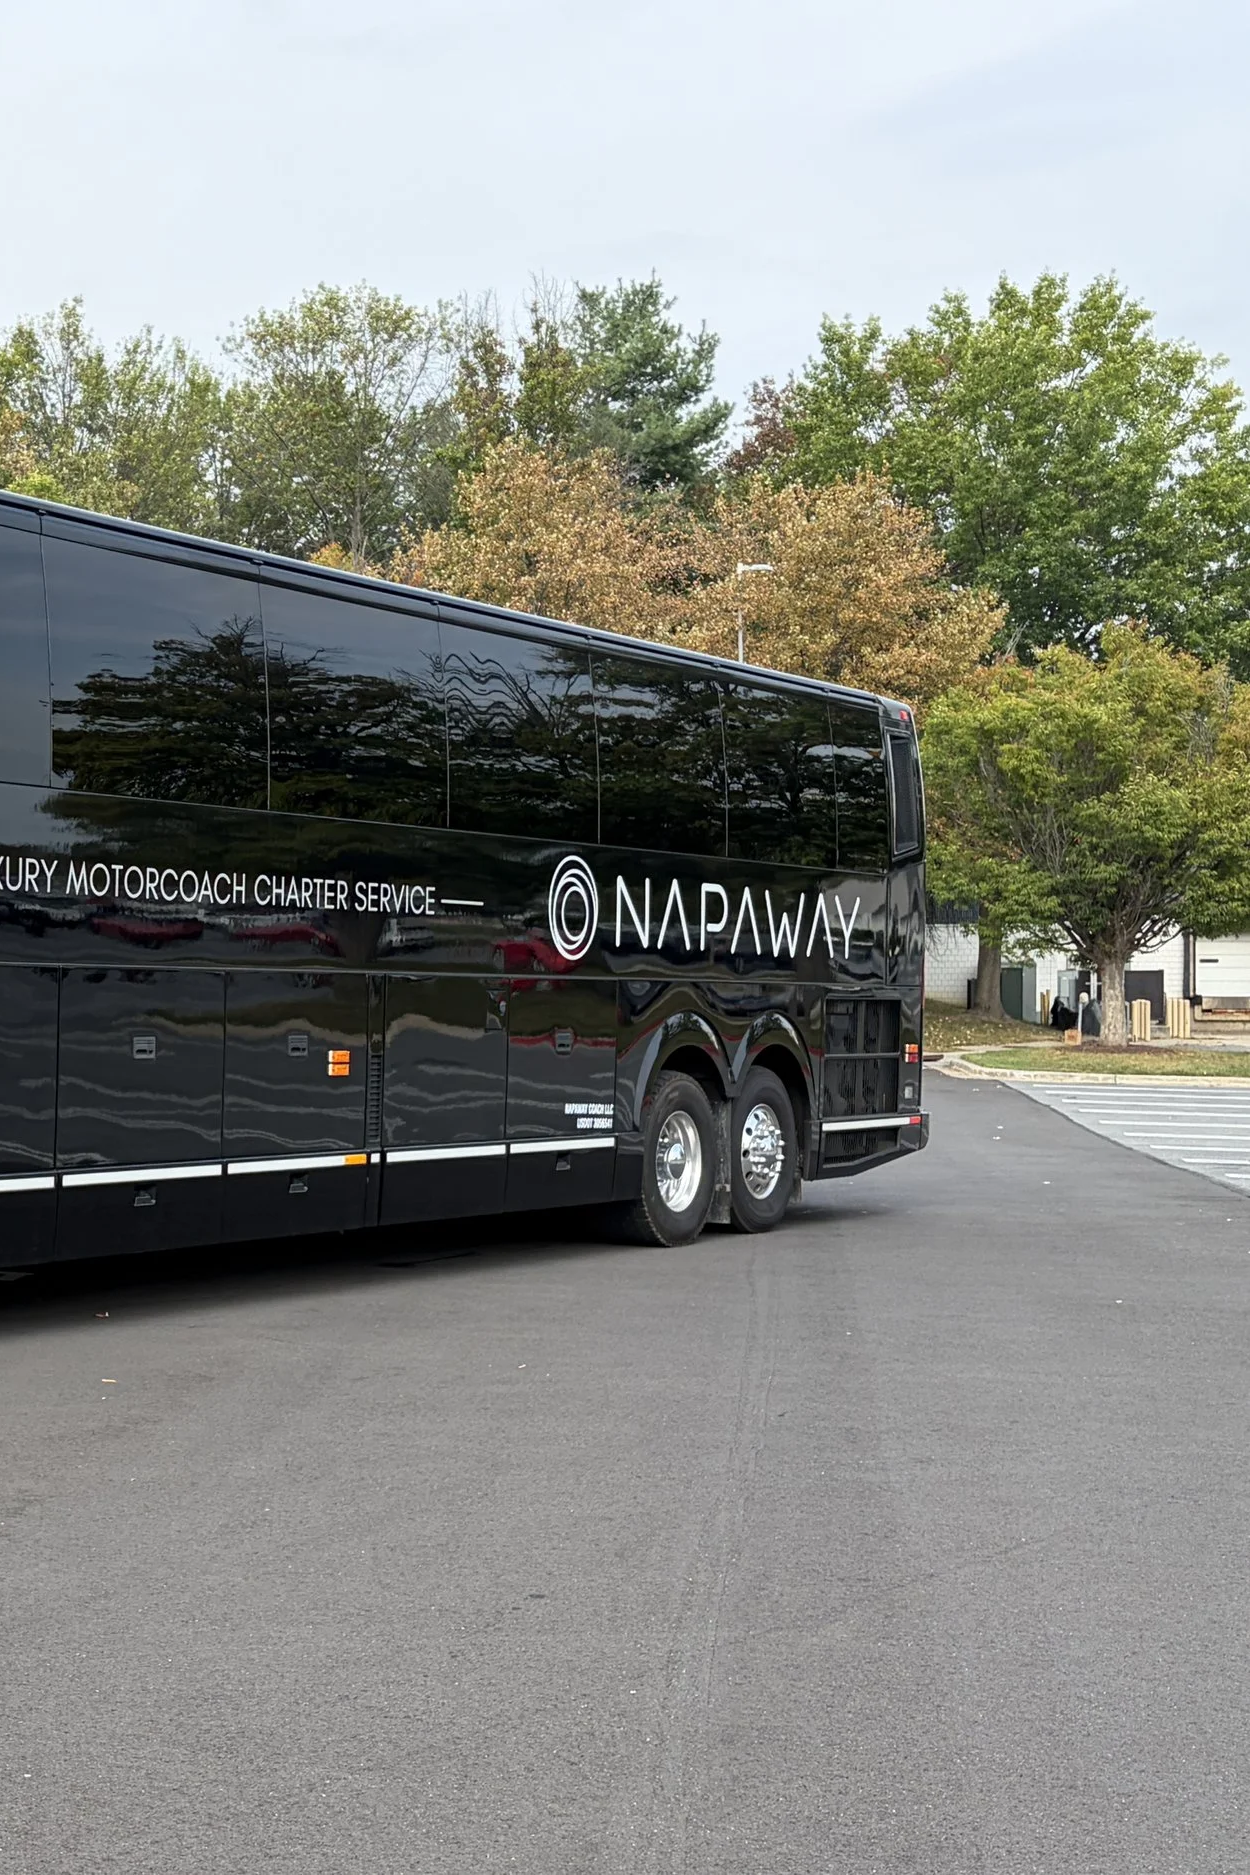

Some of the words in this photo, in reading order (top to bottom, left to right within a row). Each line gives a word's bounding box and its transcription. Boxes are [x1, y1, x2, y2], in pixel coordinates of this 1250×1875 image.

[65, 859, 246, 905] MOTORCOACH
[254, 874, 349, 911] CHARTER
[354, 881, 437, 916] SERVICE
[615, 874, 861, 960] NAPAWAY
